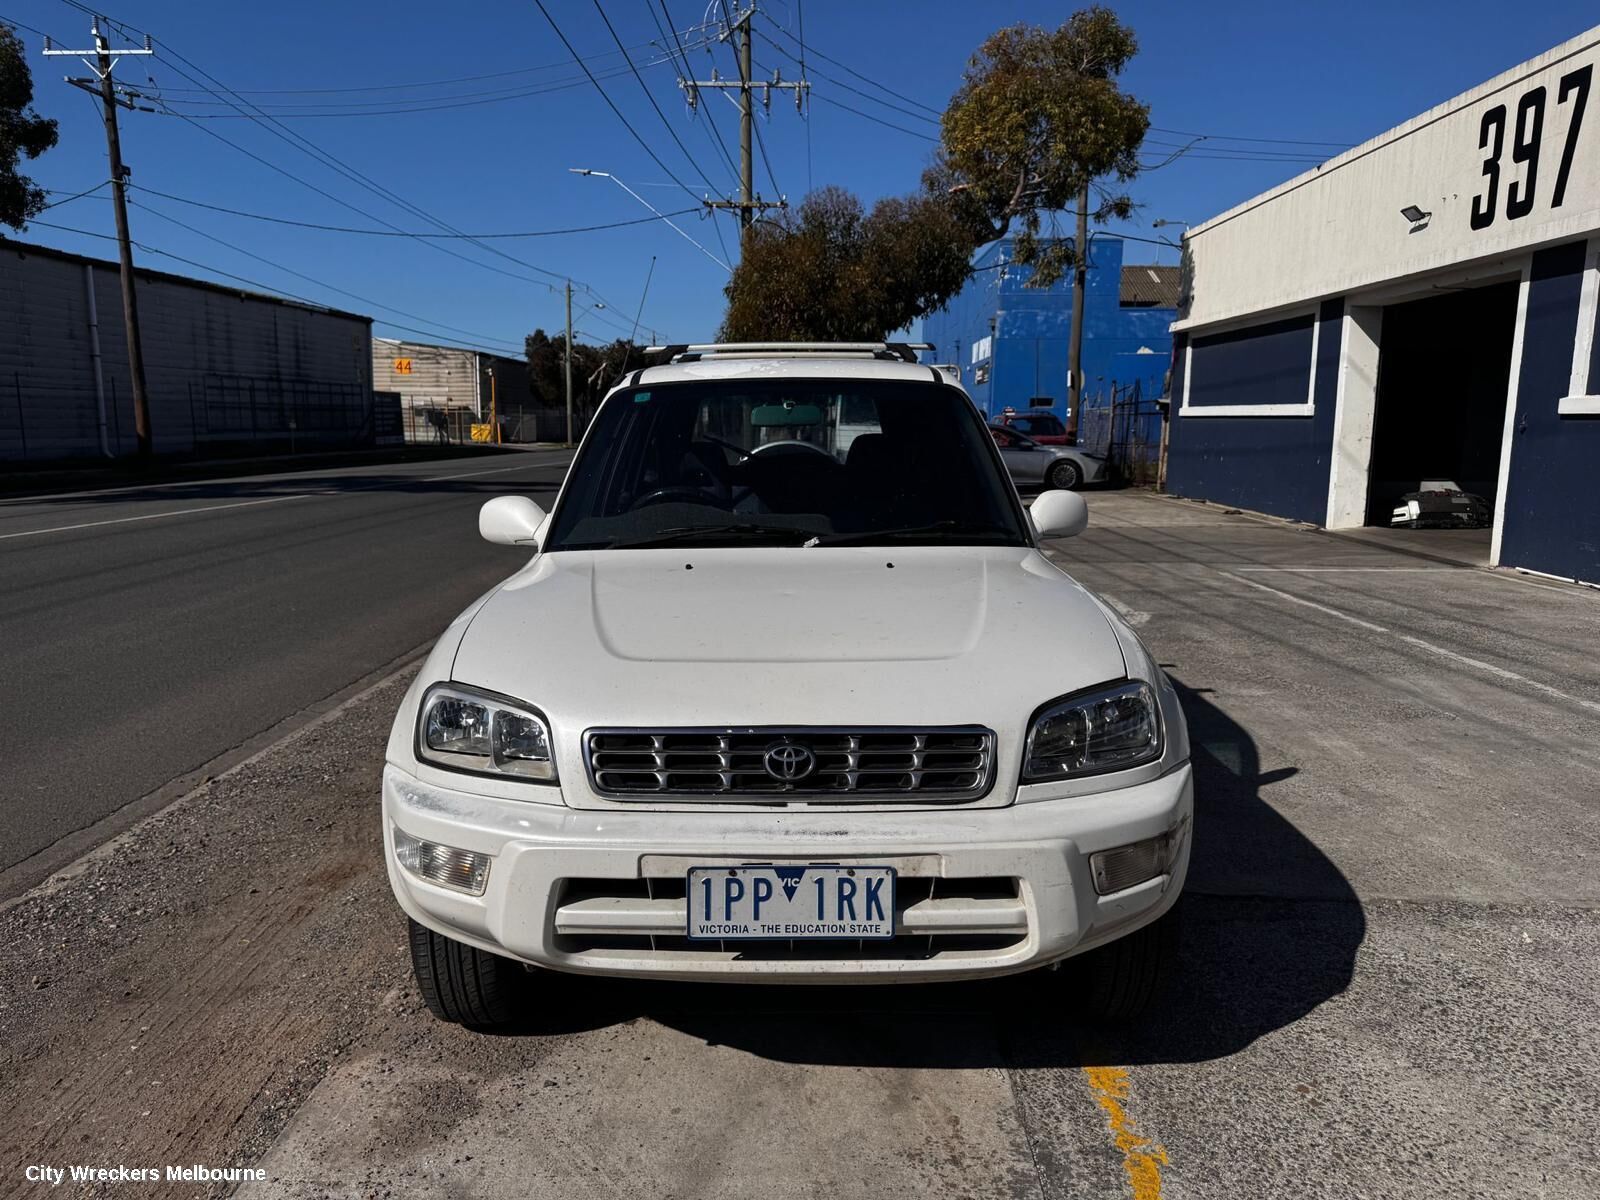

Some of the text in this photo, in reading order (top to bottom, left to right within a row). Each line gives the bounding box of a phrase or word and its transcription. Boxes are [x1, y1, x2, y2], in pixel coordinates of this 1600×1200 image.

[1470, 63, 1594, 231] 397
[396, 359, 412, 374] 44
[781, 877, 801, 888] VIC
[701, 877, 885, 922] 1PP 1RK
[699, 924, 749, 934] VICTORIA
[761, 924, 781, 934] THE
[785, 924, 846, 934] EDUCATION
[850, 924, 881, 934] STATE
